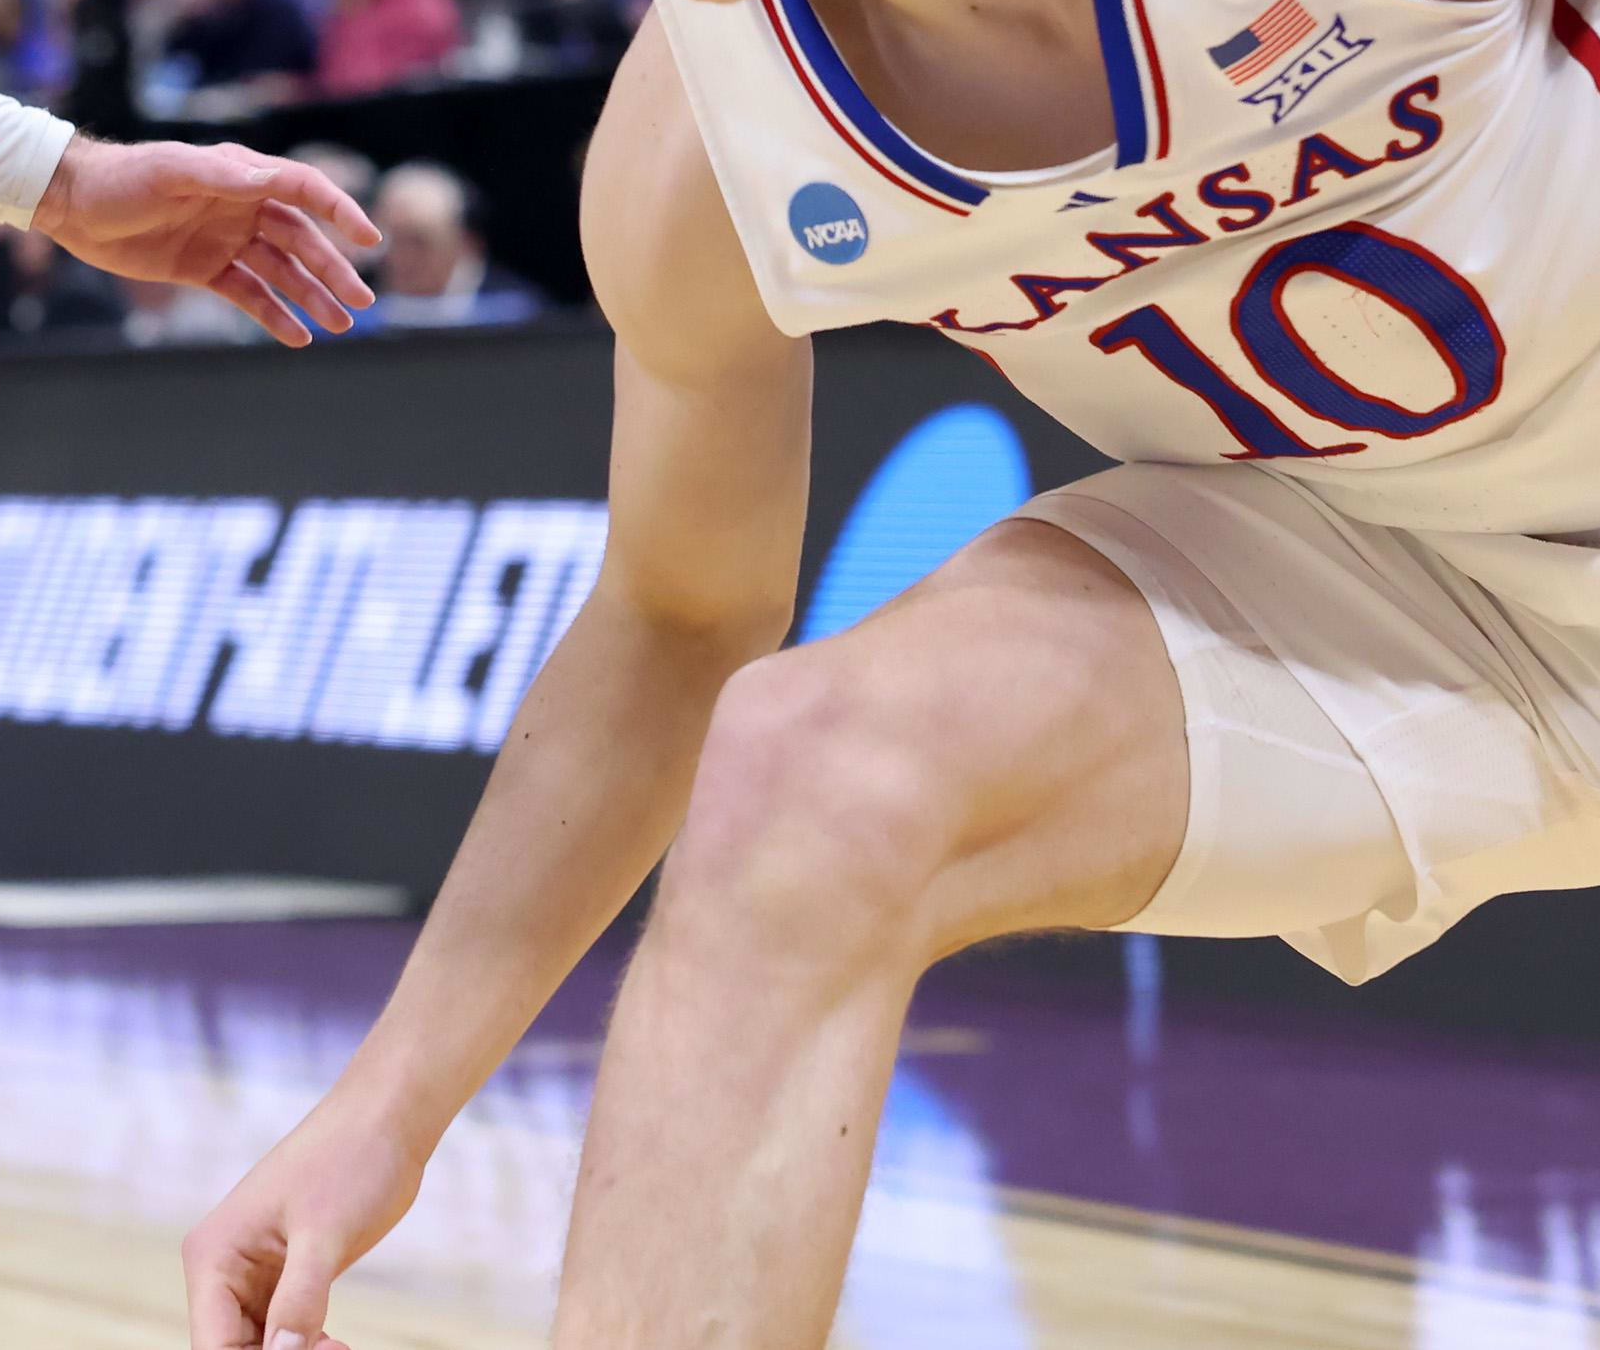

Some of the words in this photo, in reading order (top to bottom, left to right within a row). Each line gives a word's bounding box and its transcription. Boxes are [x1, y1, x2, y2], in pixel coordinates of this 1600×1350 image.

[802, 217, 866, 250] NCAA
[912, 74, 1444, 336] ANSAS
[1088, 220, 1506, 462] 10
